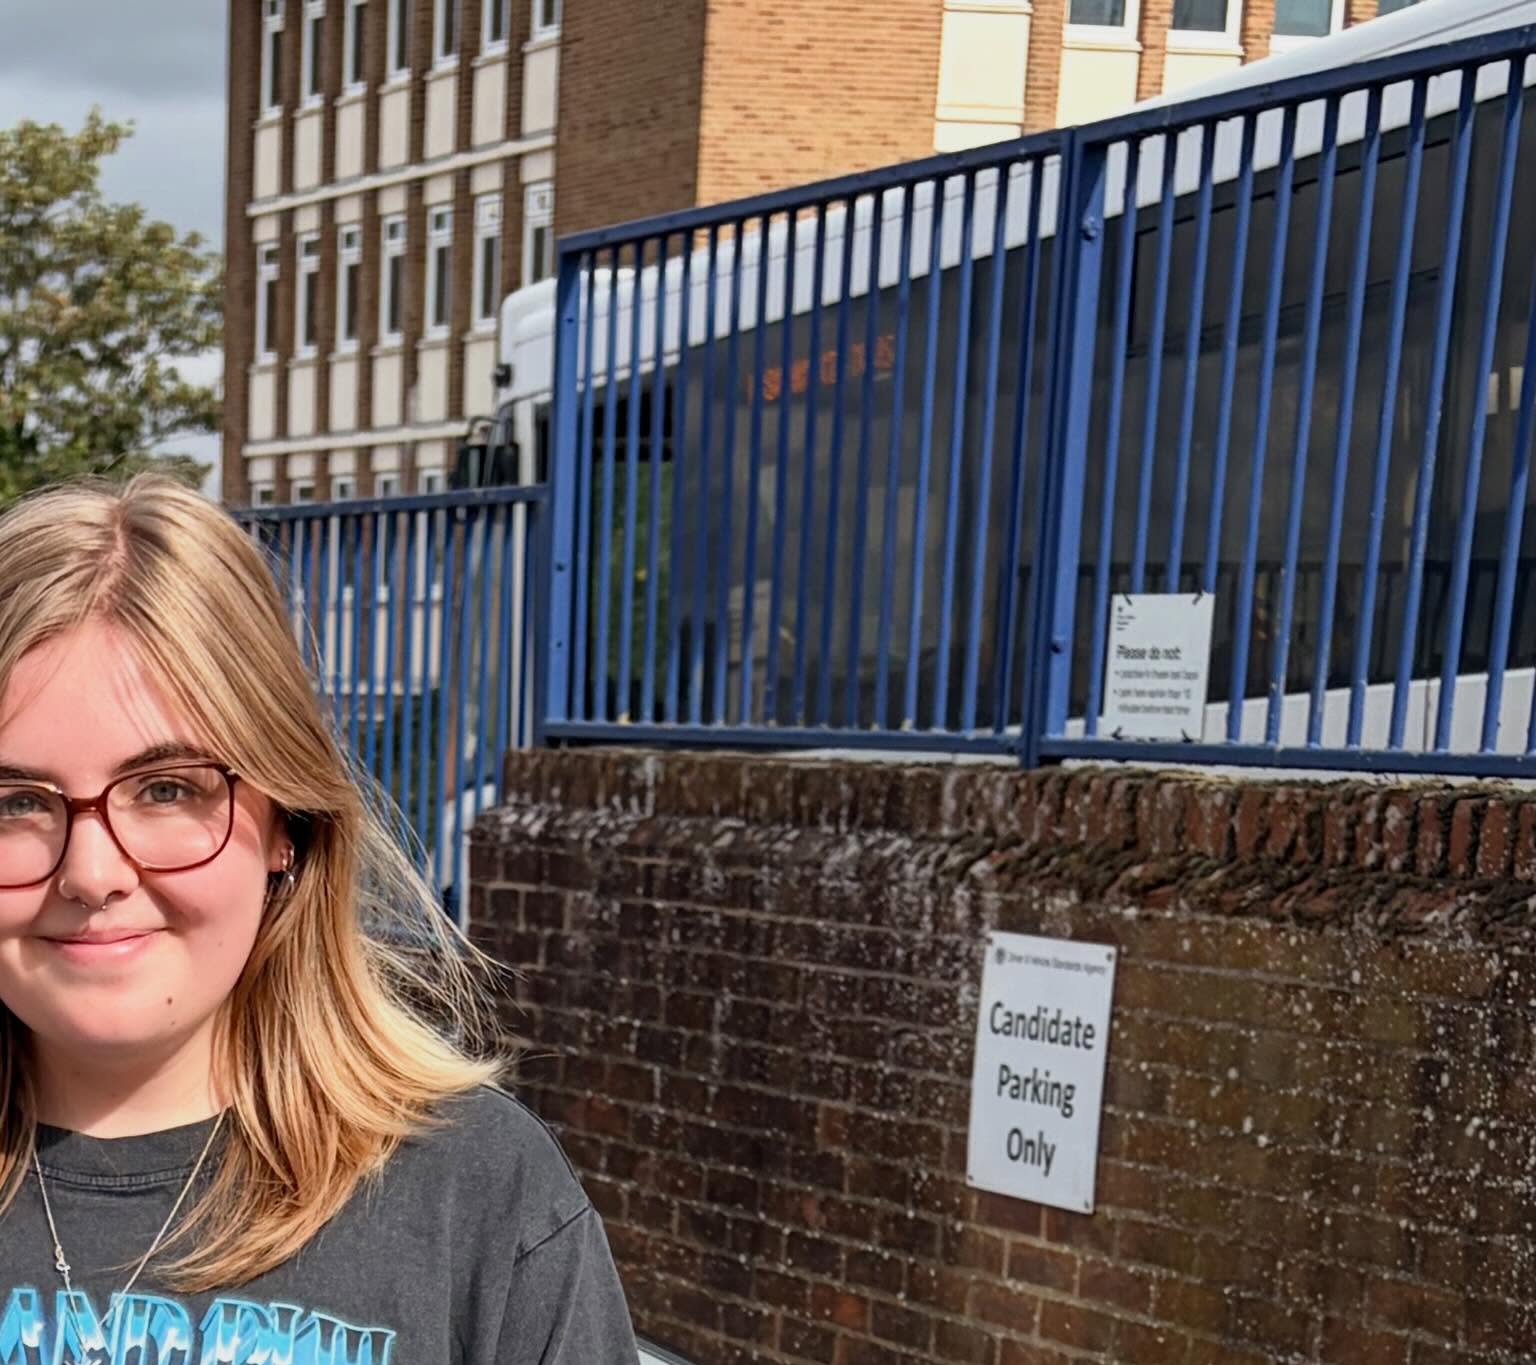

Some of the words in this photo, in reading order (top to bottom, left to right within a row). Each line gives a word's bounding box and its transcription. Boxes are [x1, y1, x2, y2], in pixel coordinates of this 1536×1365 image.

[1116, 645, 1146, 660] Please
[990, 1001, 1096, 1050] Candidate
[997, 1063, 1076, 1119] Parking
[1007, 1127, 1056, 1177] Only
